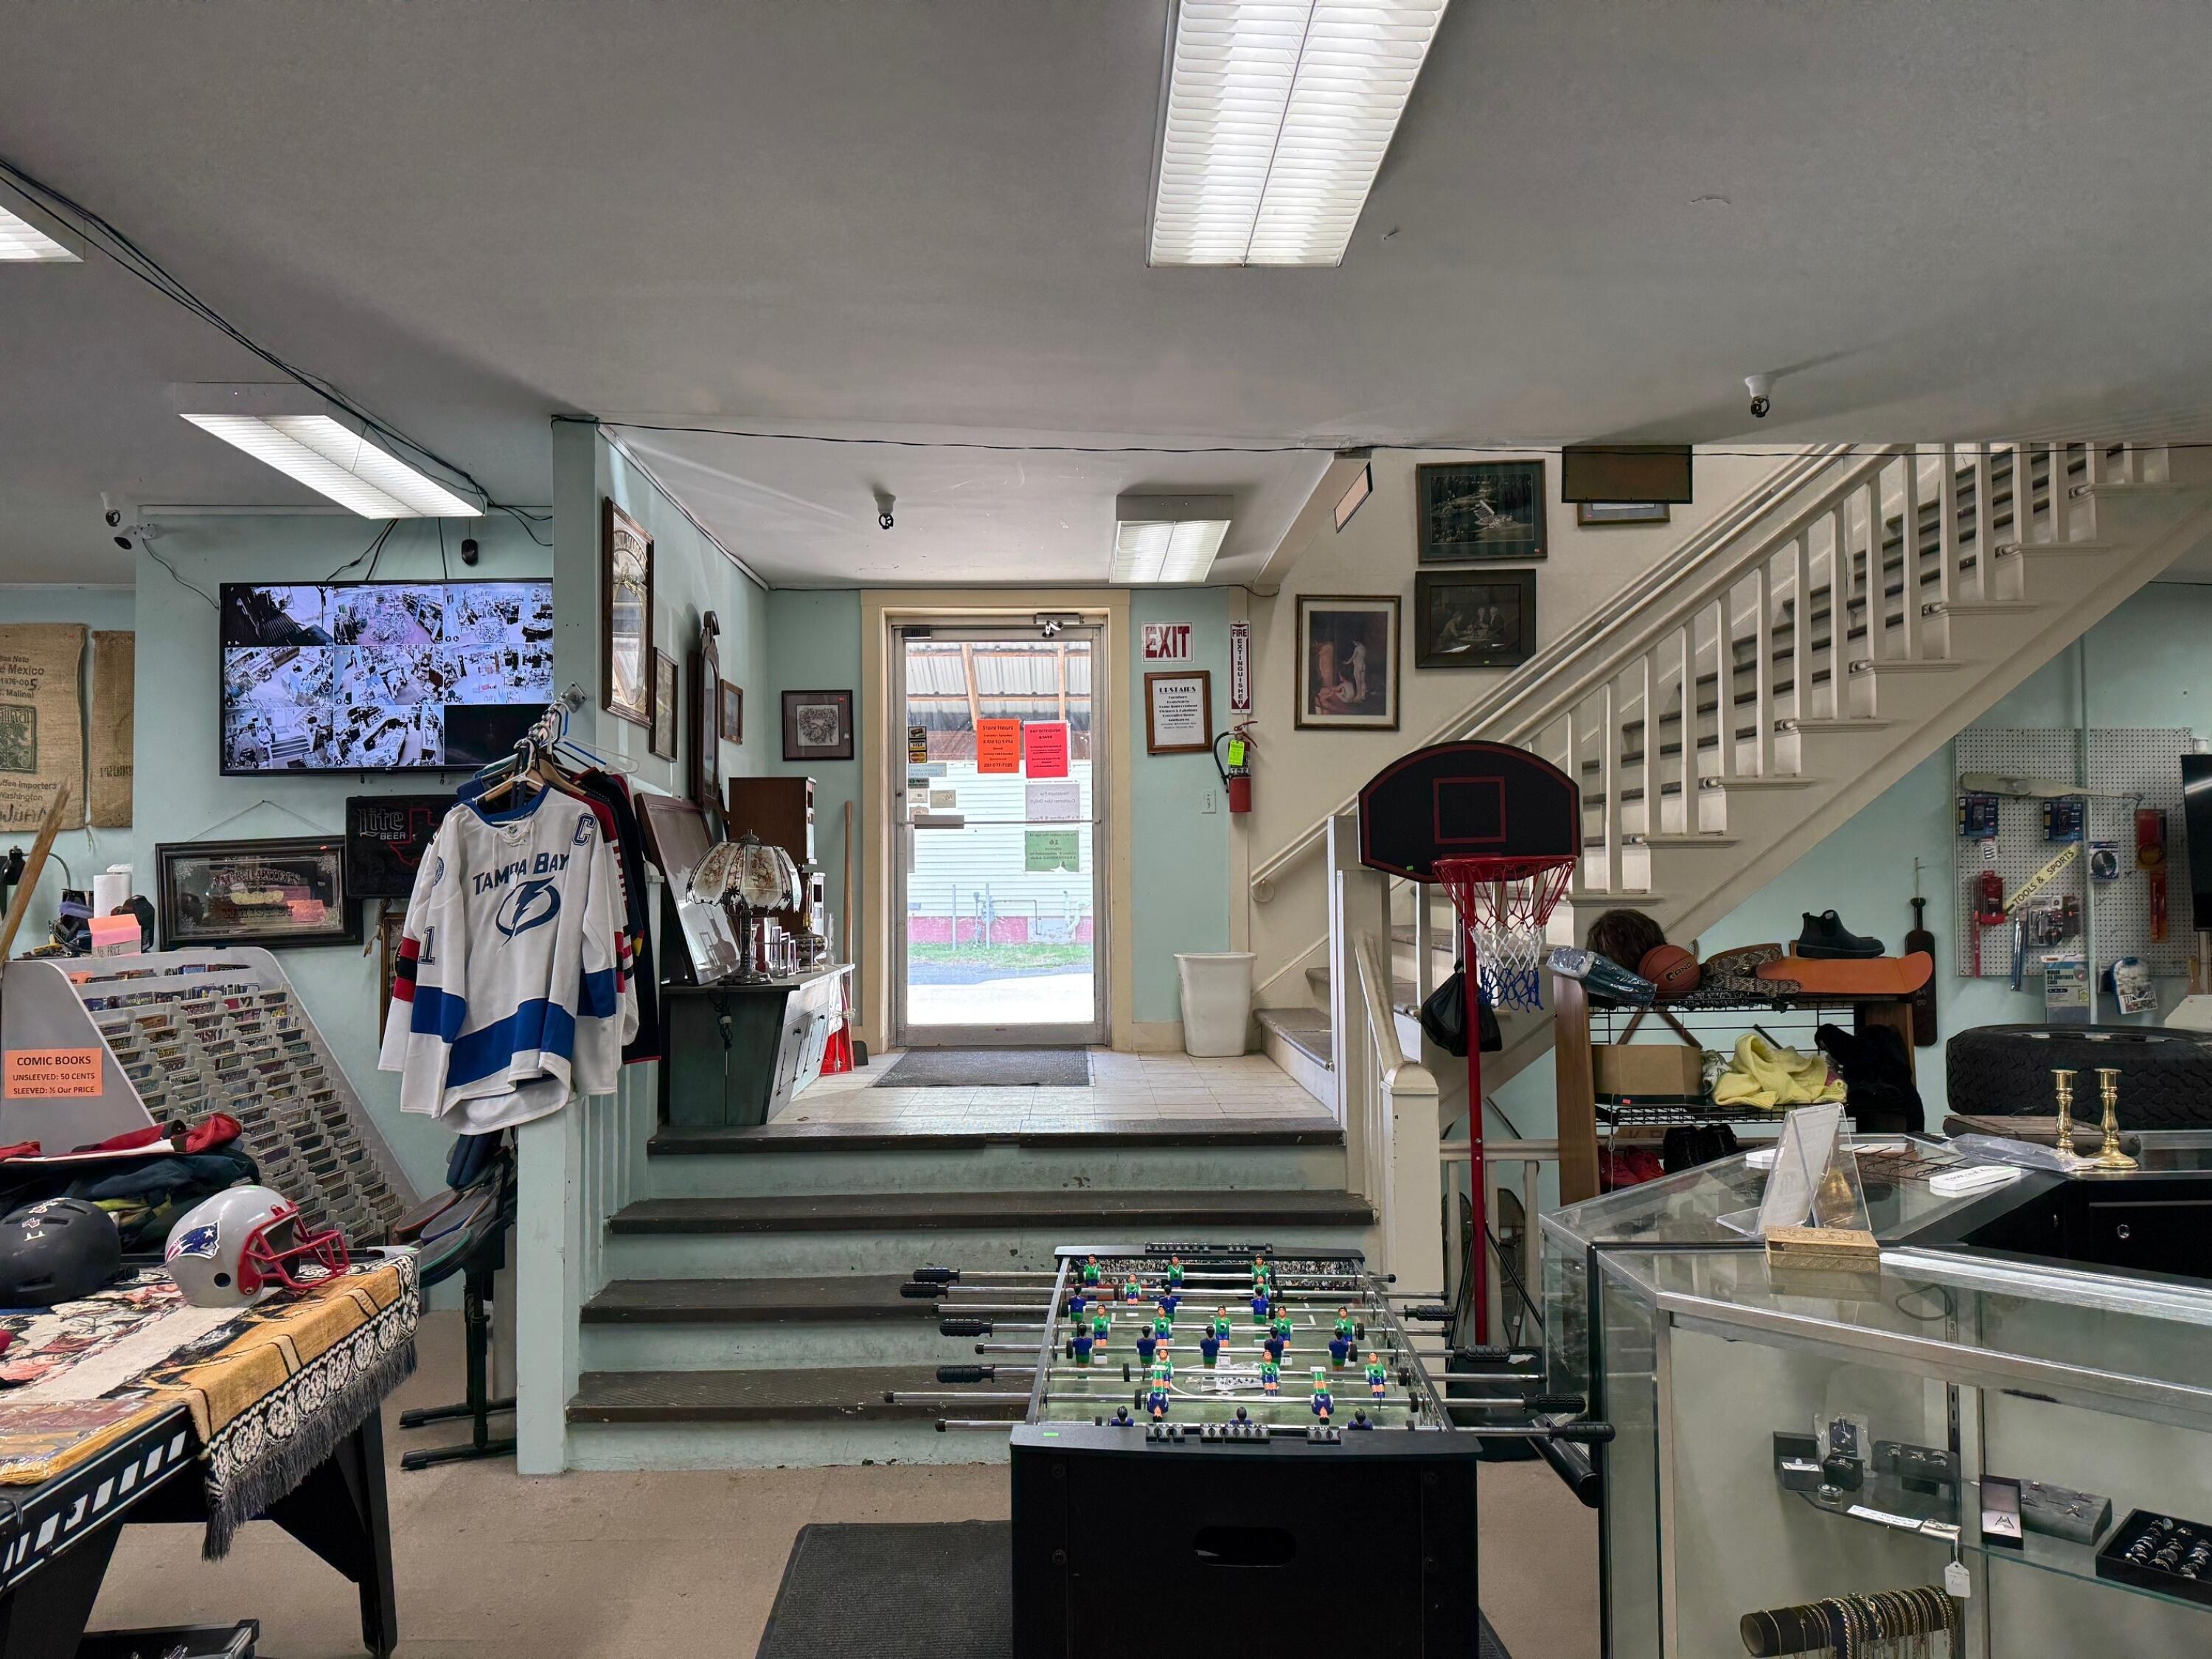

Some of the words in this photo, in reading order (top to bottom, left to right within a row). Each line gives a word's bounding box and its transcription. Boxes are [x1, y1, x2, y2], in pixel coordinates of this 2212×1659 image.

[1232, 629, 1248, 638] FIRE
[1145, 625, 1190, 658] EXIT
[8, 664, 44, 675] Mexico
[357, 808, 404, 838] Lite
[571, 813, 597, 846] C
[380, 832, 406, 841] BEER
[473, 859, 527, 896] TAMPA
[533, 852, 569, 873] BAY
[2012, 882, 2038, 906] TOOLS
[2037, 876, 2045, 884] &
[2046, 849, 2076, 875] SPORTS
[108, 945, 121, 957] PRICE
[17, 1057, 52, 1066] COMIC
[55, 1055, 91, 1065] BOOKS
[13, 1073, 59, 1082] UNSLEEVED:
[72, 1072, 95, 1080] CENTS
[13, 1087, 48, 1095] SLEEVED:
[73, 1086, 94, 1094] PRICE
